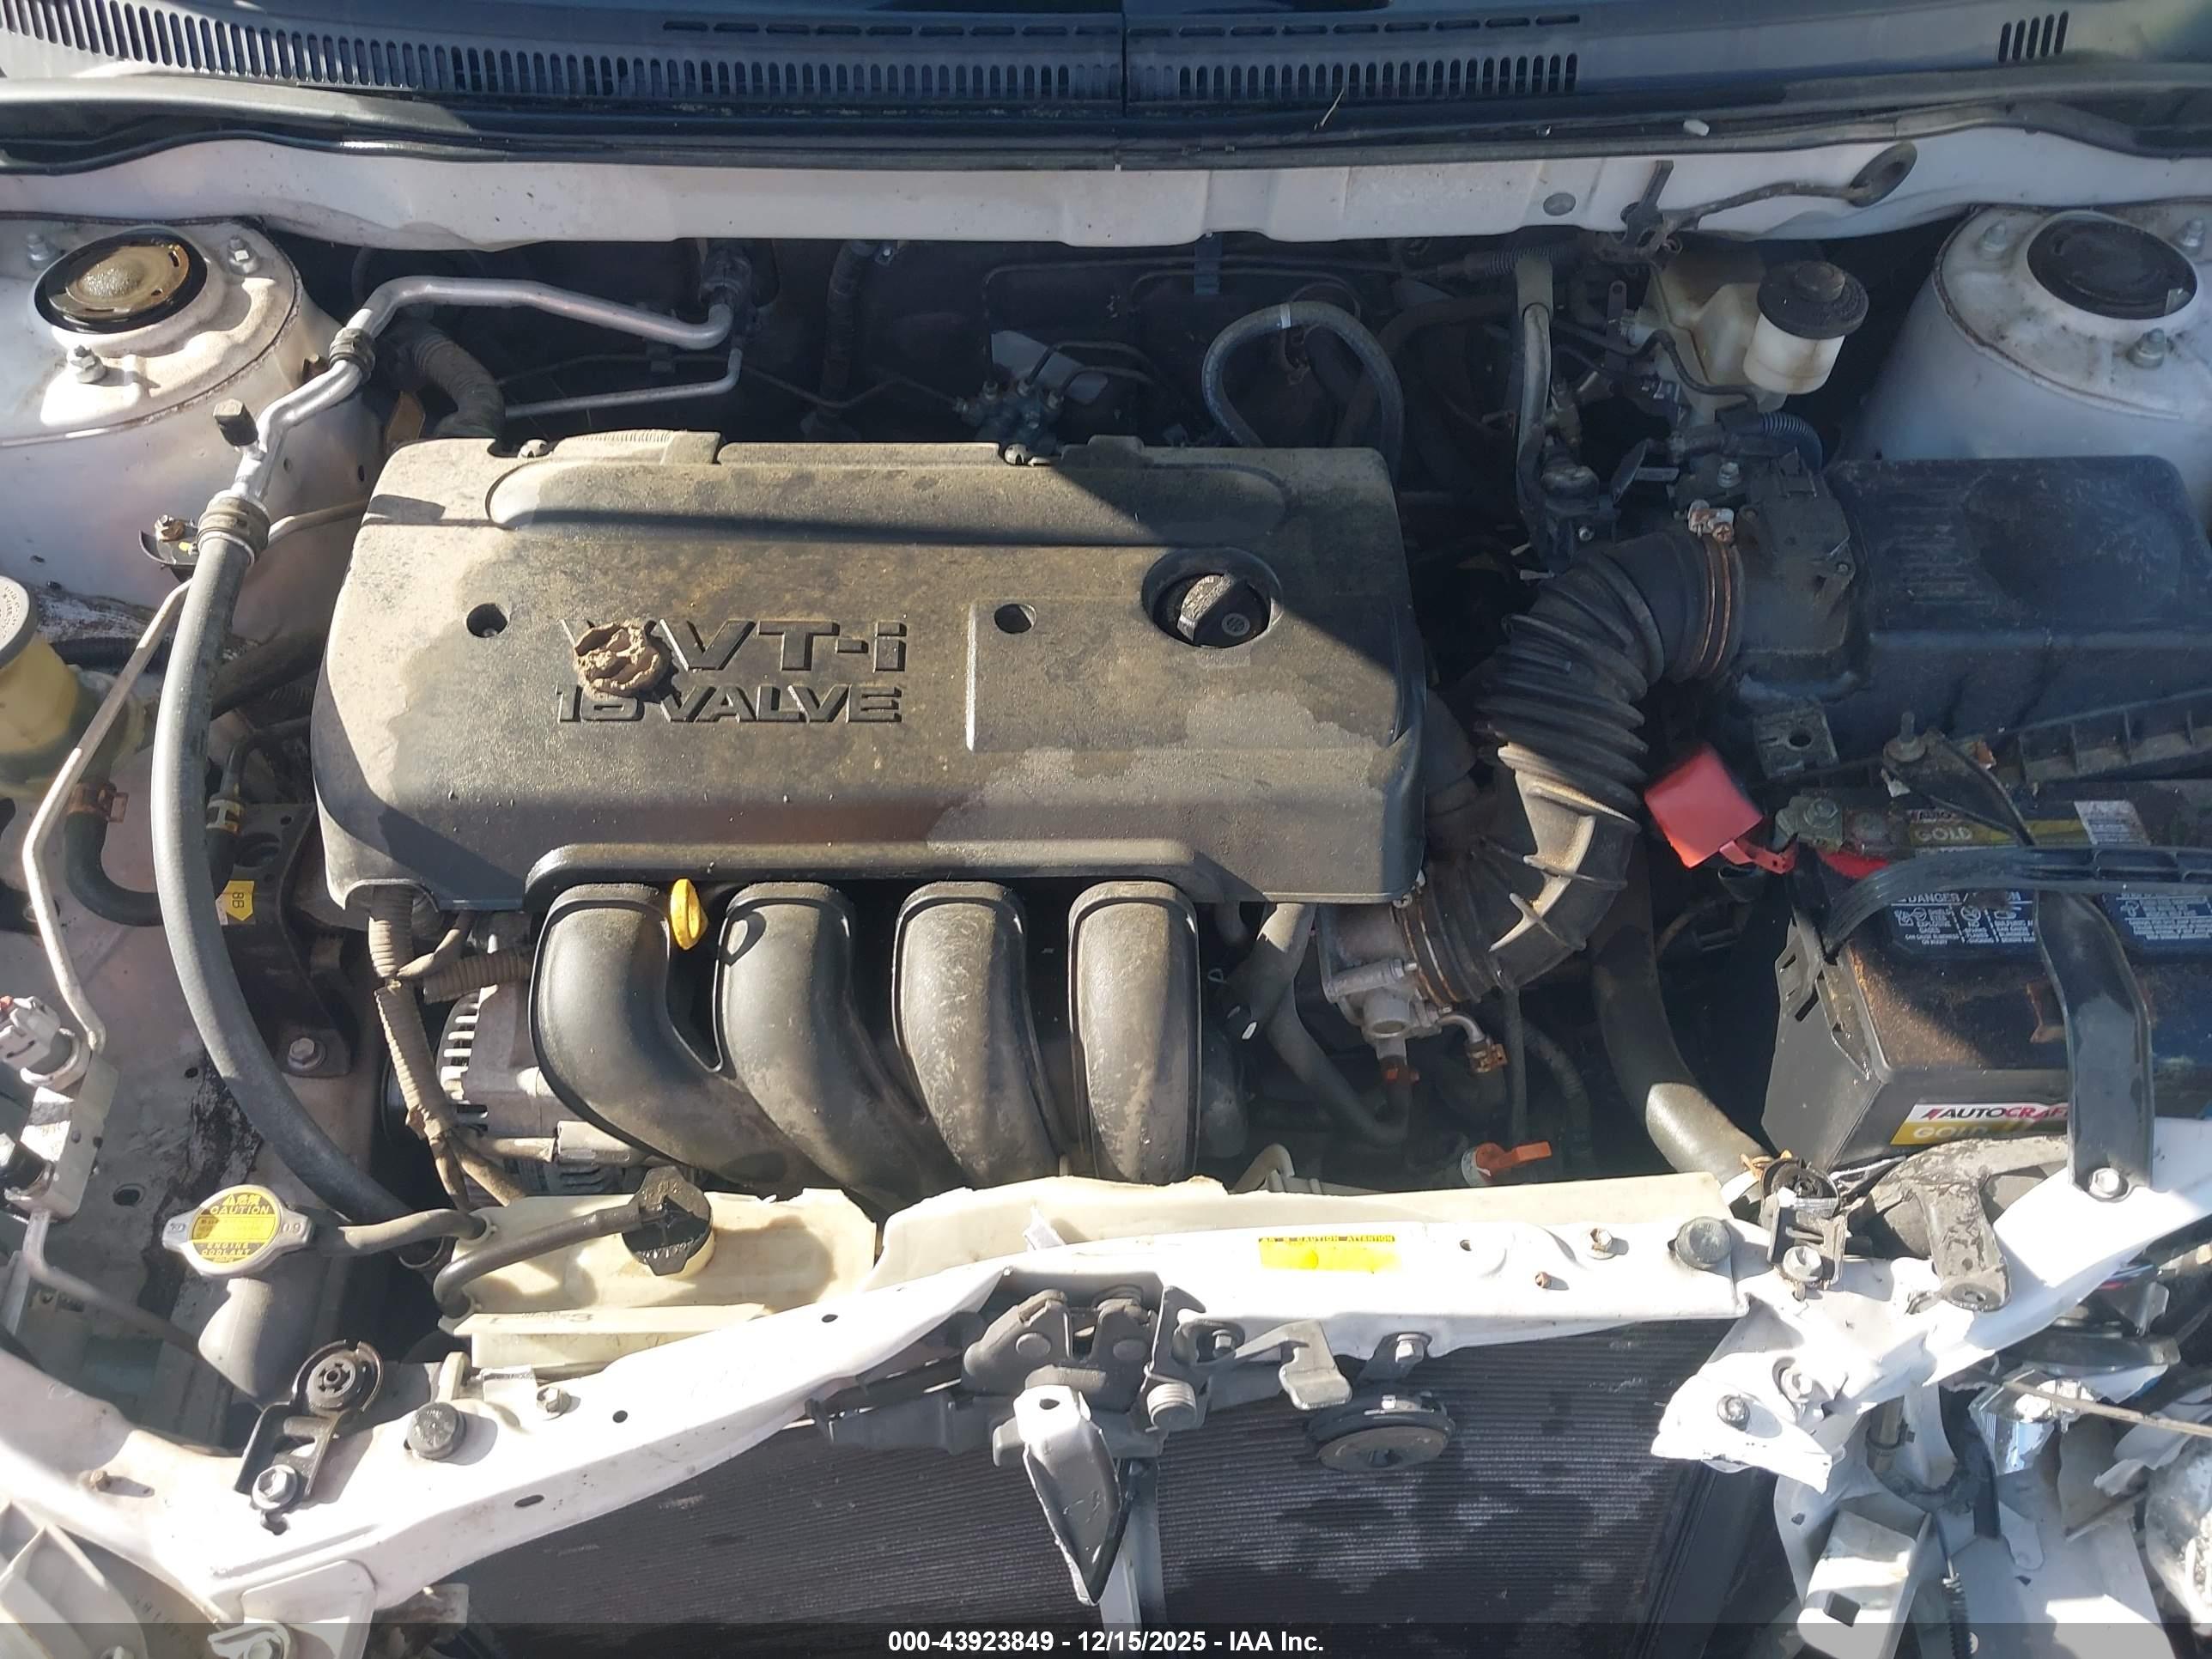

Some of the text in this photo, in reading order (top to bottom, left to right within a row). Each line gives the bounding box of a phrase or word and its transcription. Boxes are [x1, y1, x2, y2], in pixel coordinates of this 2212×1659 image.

[661, 684, 903, 724] VALVE
[1915, 827, 1973, 842] GOLD
[210, 1205, 270, 1215] CAUTION
